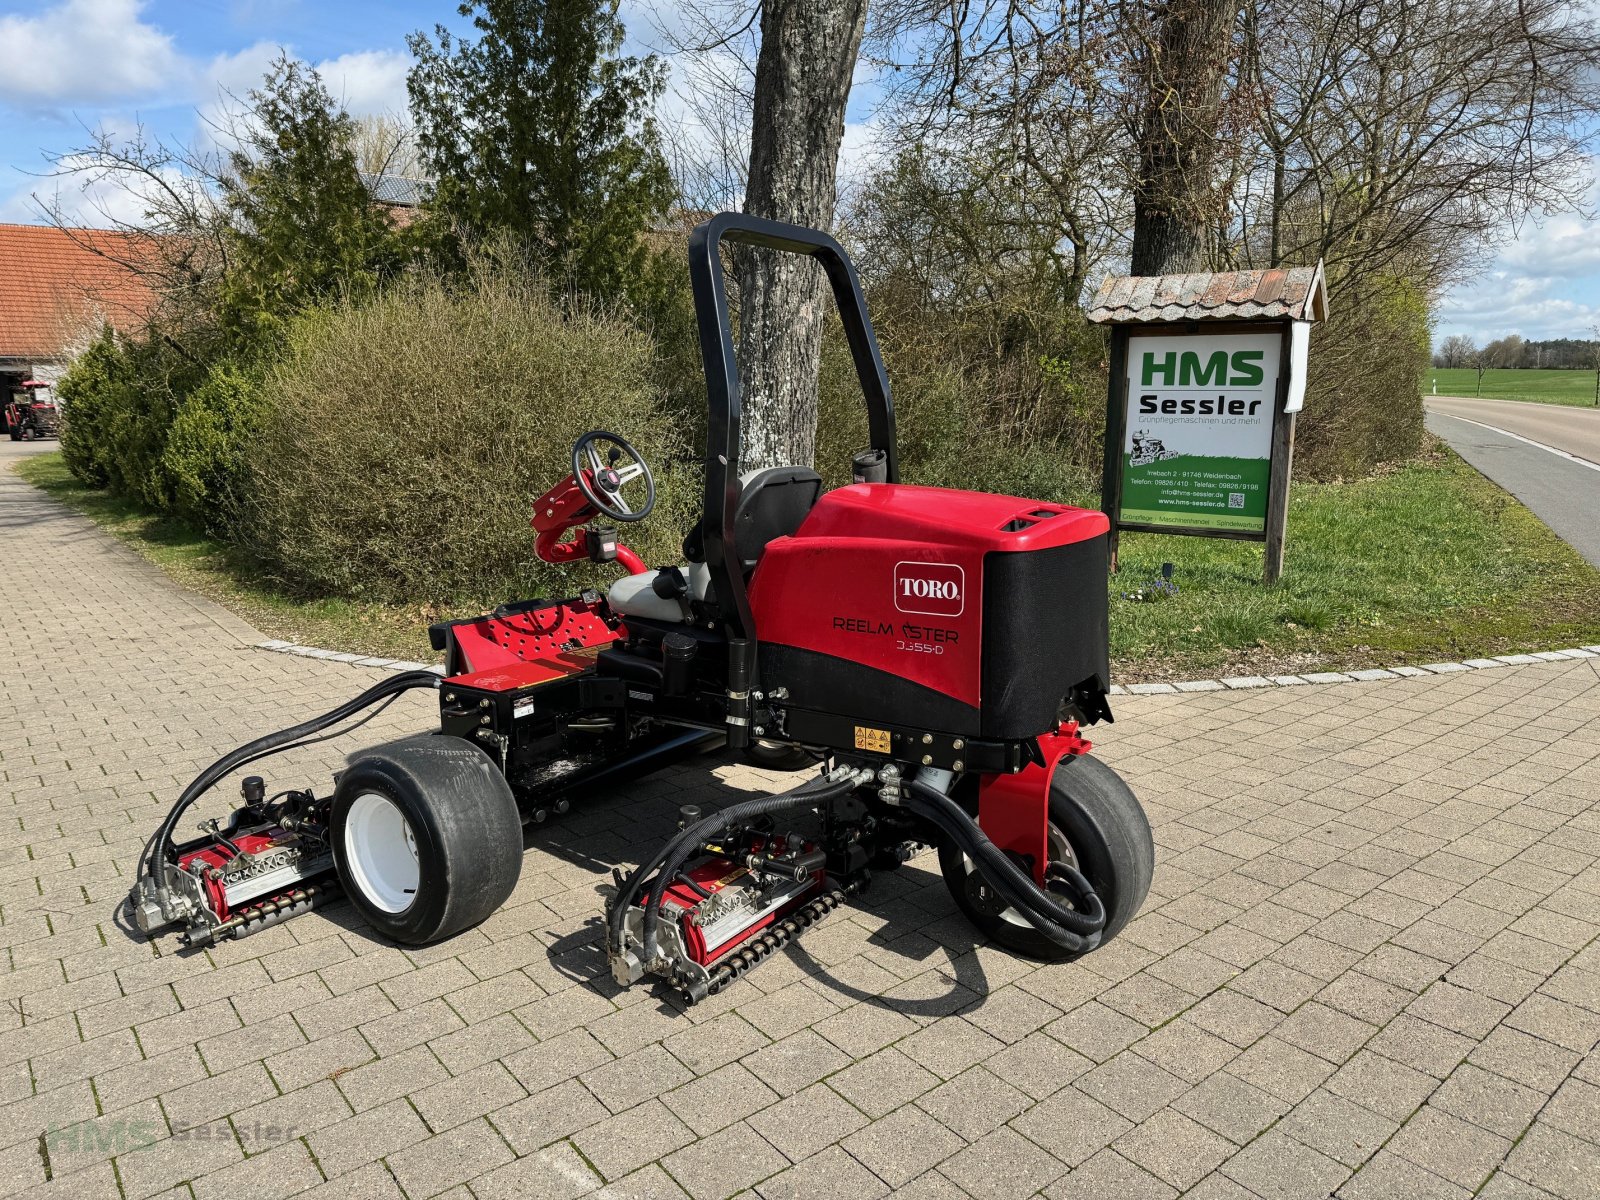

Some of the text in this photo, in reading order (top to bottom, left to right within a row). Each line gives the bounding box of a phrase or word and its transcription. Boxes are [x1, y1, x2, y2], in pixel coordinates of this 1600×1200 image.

[1141, 351, 1264, 386] HMS
[1139, 395, 1262, 416] Sessler
[1221, 417, 1236, 425] und
[1161, 489, 1224, 498] info@hms-sessler.de
[1158, 499, 1226, 508] www.hms-sessler.de
[1159, 516, 1209, 525] Maschinenhandel
[1216, 520, 1263, 529] Spindelwartung
[900, 578, 957, 600] TORO
